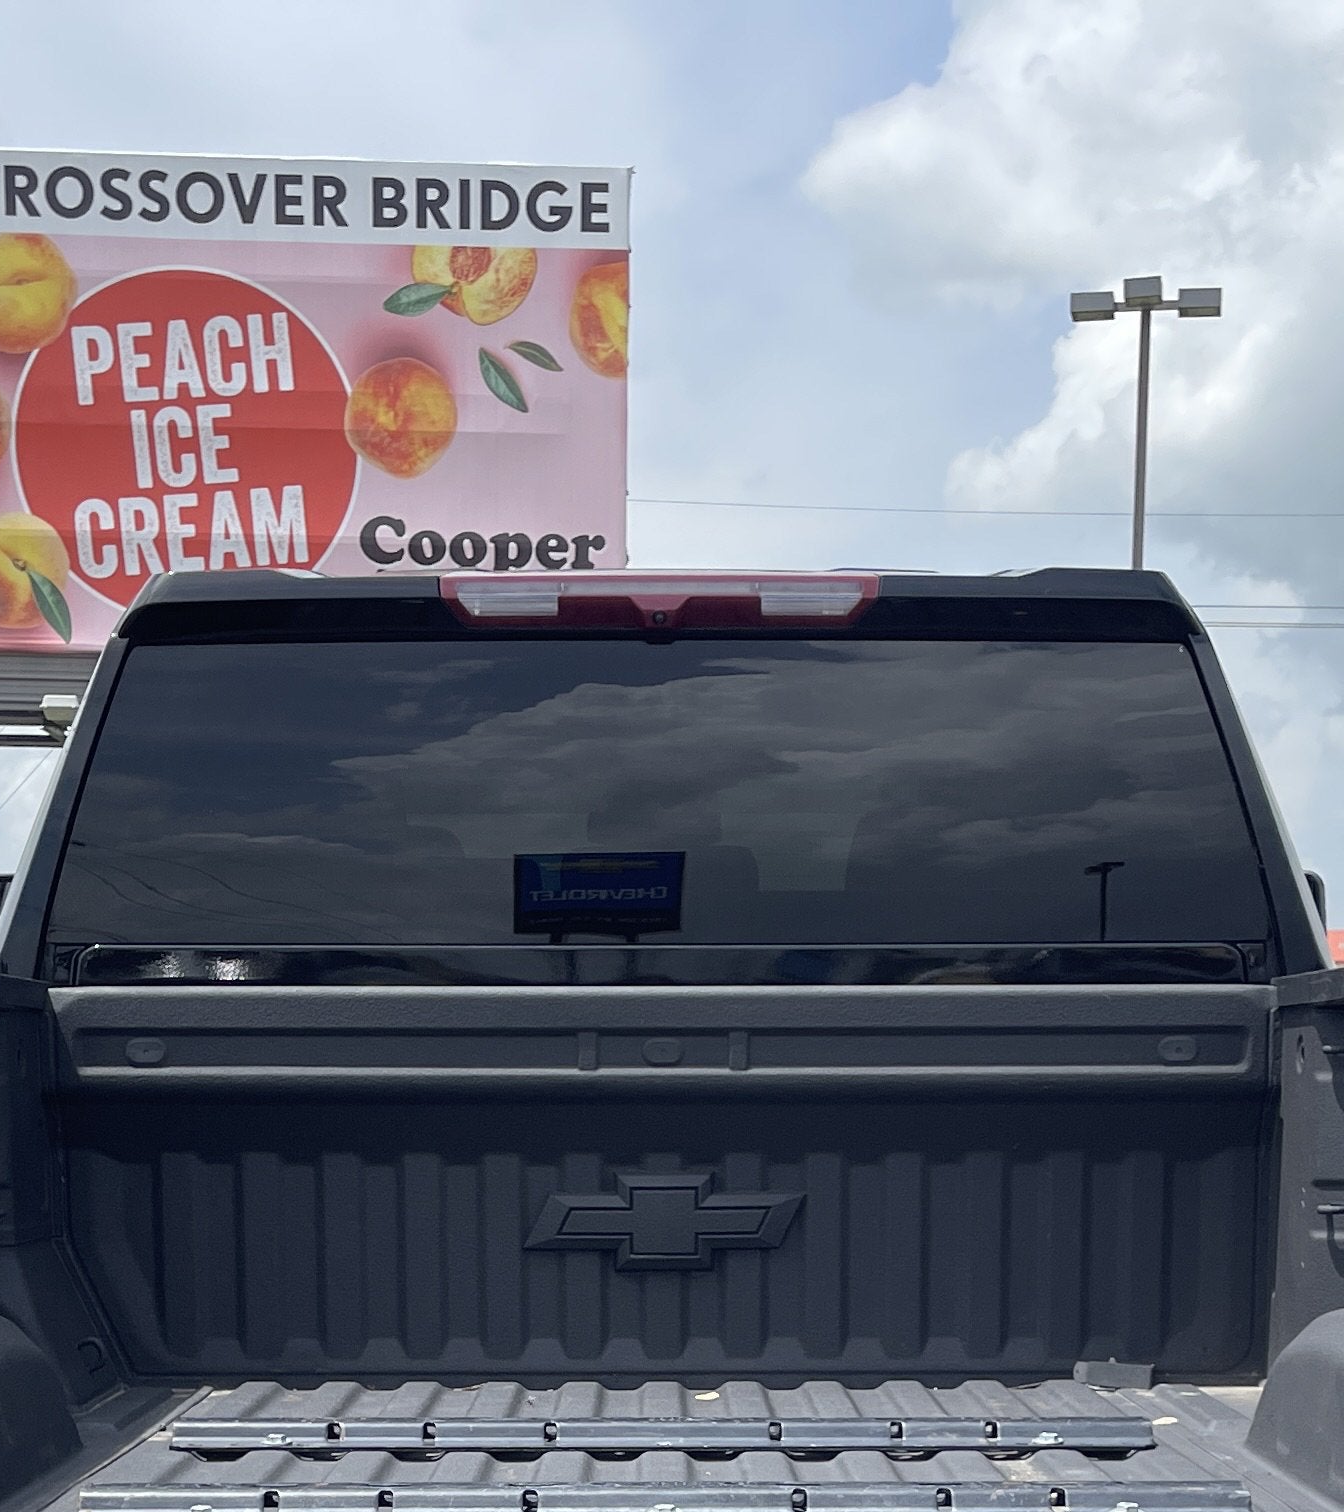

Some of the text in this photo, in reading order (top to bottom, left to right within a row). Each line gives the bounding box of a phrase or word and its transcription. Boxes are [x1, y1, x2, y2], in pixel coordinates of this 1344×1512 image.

[372, 177, 610, 232] BRIDGE
[71, 312, 295, 405] PEACH
[130, 404, 239, 489] ICE
[74, 485, 309, 578] CREAM
[360, 516, 605, 570] Cooper
